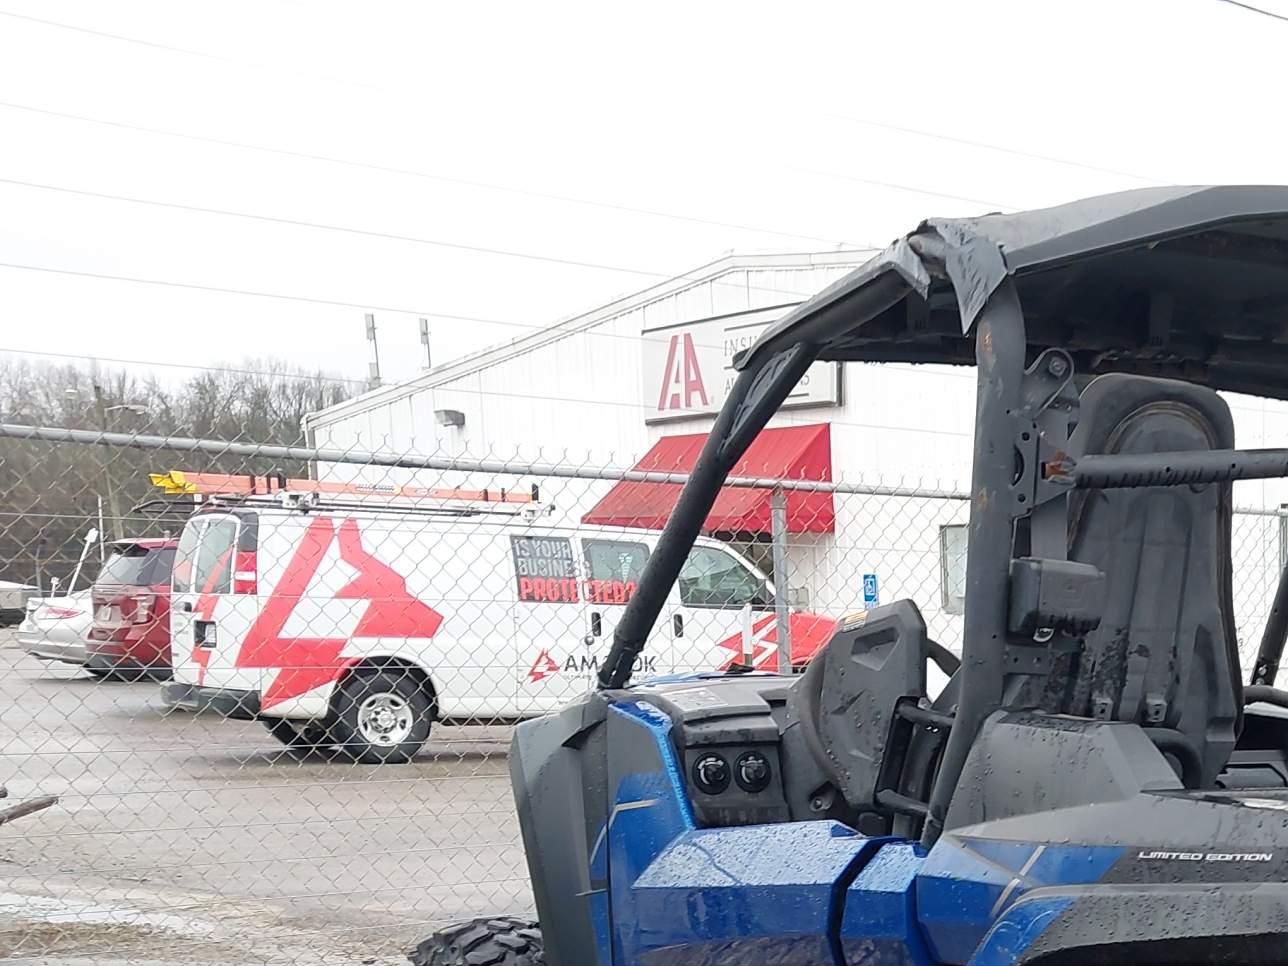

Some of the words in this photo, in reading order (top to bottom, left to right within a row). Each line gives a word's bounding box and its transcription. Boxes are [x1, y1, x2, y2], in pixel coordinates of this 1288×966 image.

[513, 539, 530, 556] IS
[531, 540, 572, 559] YOUR
[563, 654, 657, 673] AMOK
[1137, 850, 1203, 861] LIMITED
[1204, 852, 1274, 862] EDITION
